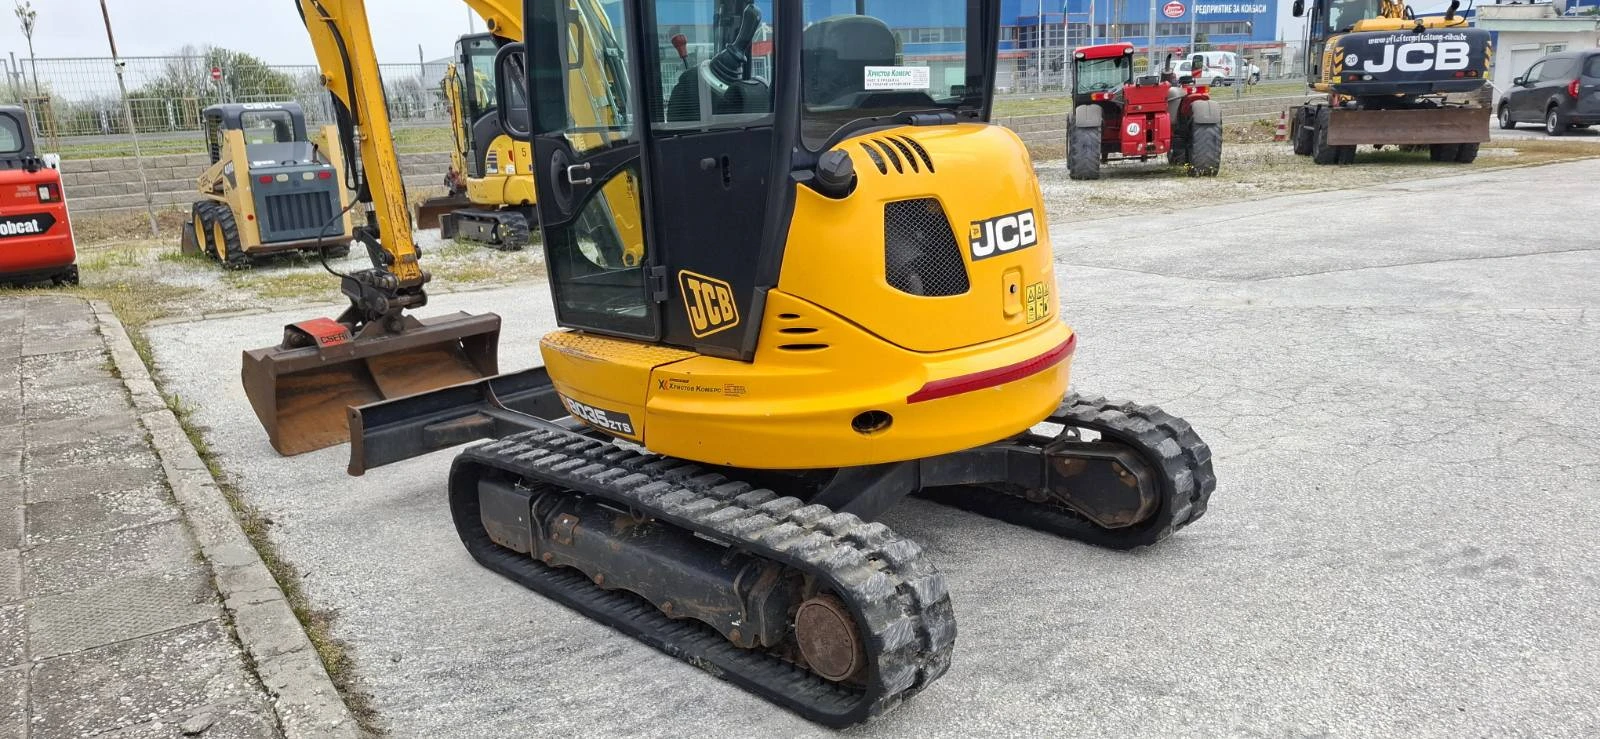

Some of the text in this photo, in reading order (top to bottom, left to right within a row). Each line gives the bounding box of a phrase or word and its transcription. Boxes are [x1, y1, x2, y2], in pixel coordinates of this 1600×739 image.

[1195, 4, 1232, 14] РЕДПРИЯТИЕ
[1233, 4, 1240, 14] ЗА
[1241, 4, 1267, 14] КОЛБАСИ
[1363, 42, 1470, 73] JCB
[1129, 124, 1138, 134] 40
[521, 147, 527, 157] 5
[0, 218, 39, 235] obcat
[972, 212, 1036, 257] JCB
[687, 277, 734, 330] JCB
